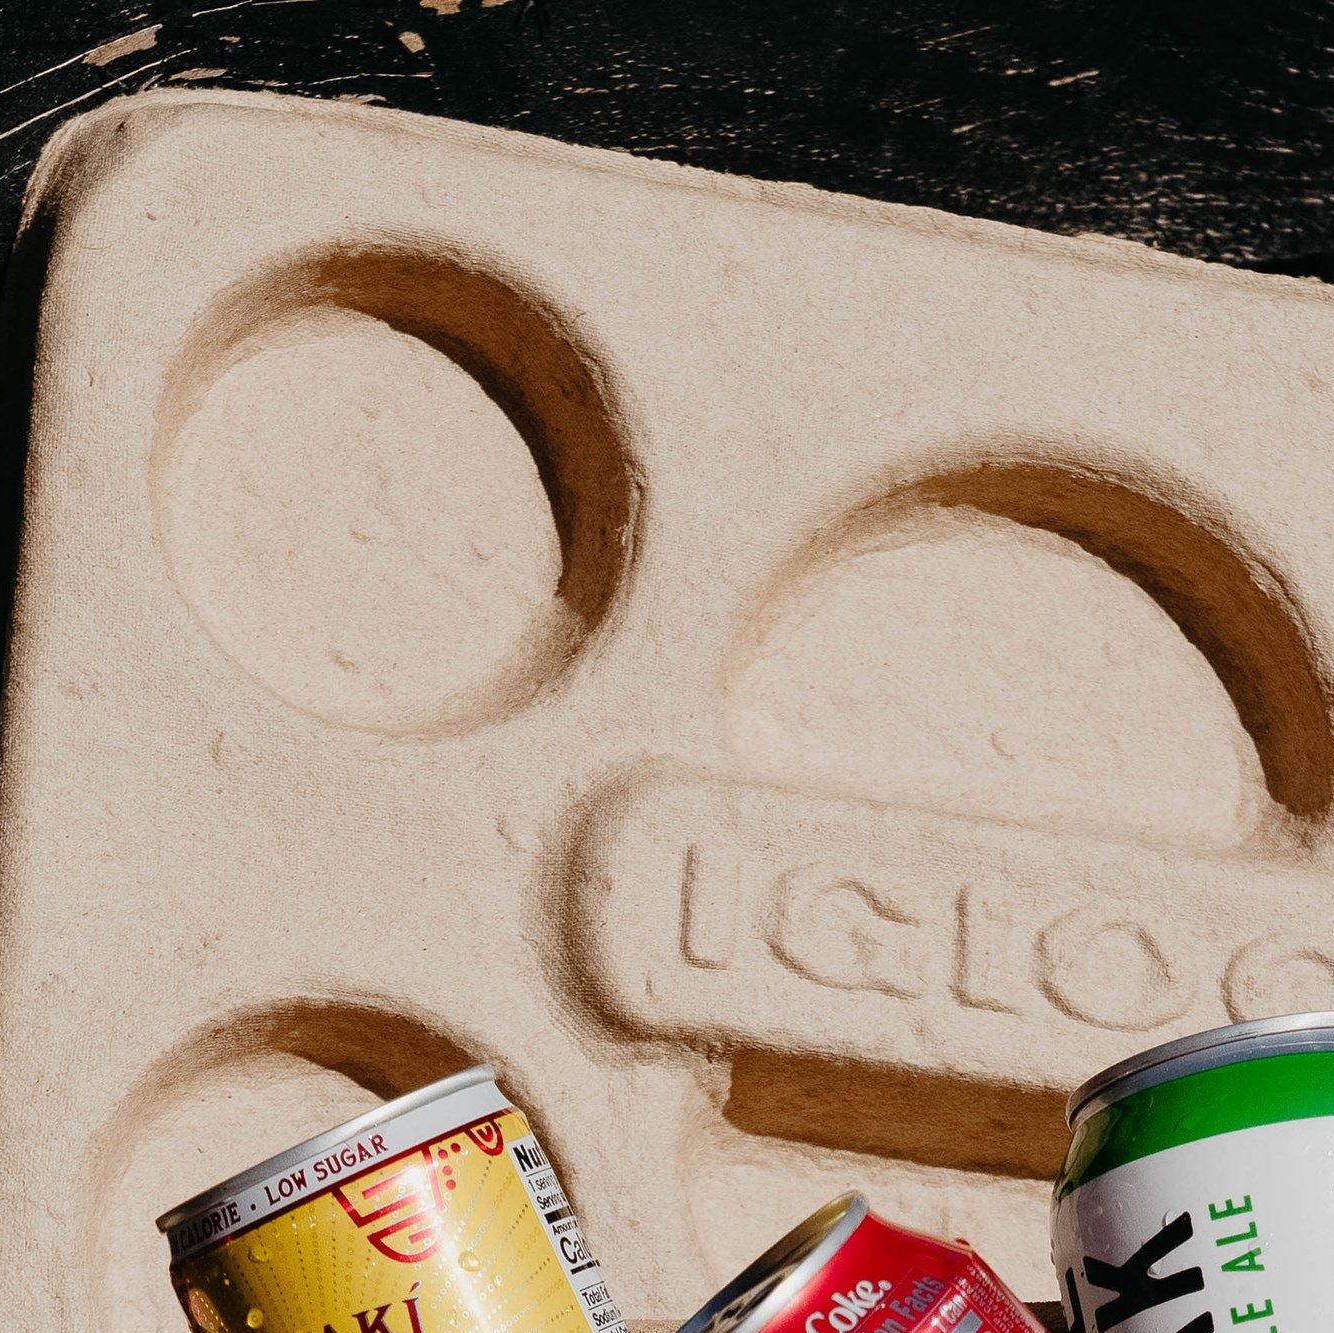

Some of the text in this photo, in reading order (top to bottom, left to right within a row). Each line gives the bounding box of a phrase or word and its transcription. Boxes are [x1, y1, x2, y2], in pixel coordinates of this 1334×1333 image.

[264, 1169, 308, 1206] LOW
[313, 1134, 389, 1181] SUGAR
[1208, 1195, 1266, 1272] ALE
[889, 1266, 947, 1325] Facts
